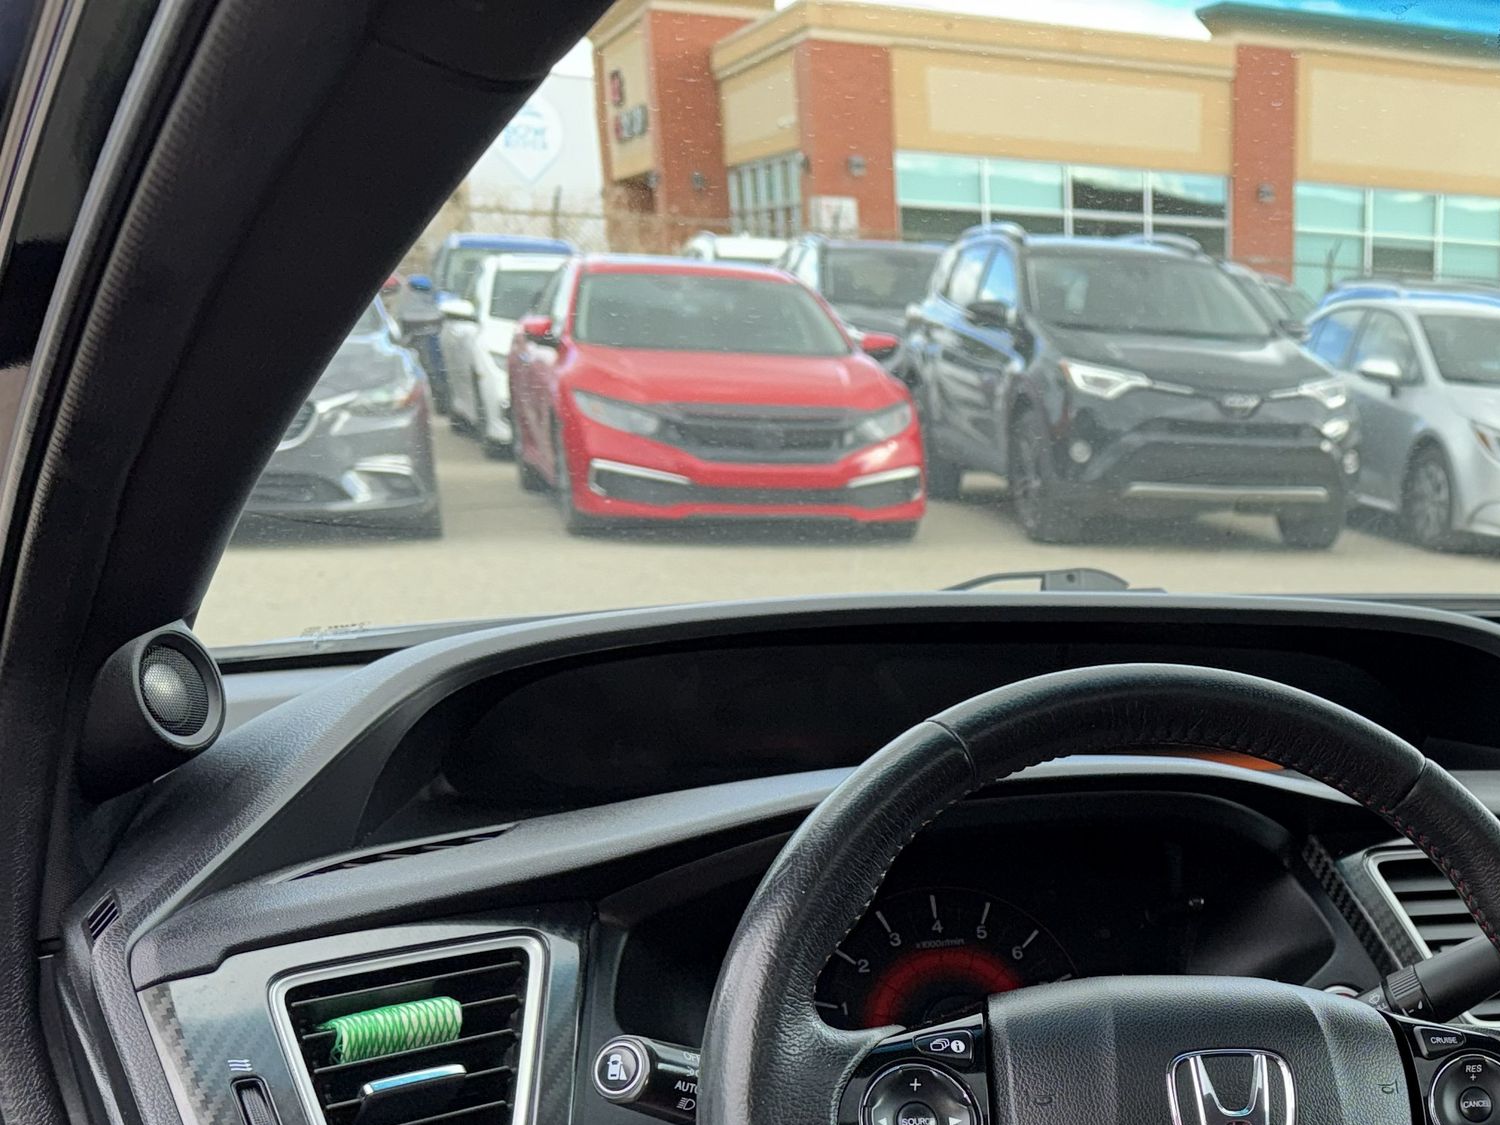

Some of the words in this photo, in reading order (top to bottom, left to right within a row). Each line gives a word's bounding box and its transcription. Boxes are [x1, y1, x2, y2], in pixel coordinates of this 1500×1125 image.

[931, 920, 943, 933] 4
[976, 925, 987, 939] 5
[889, 932, 901, 946] 3
[1012, 945, 1023, 960] 6
[857, 959, 869, 973] 2
[1430, 1035, 1458, 1045] CRUISE
[1465, 1064, 1482, 1073] RES
